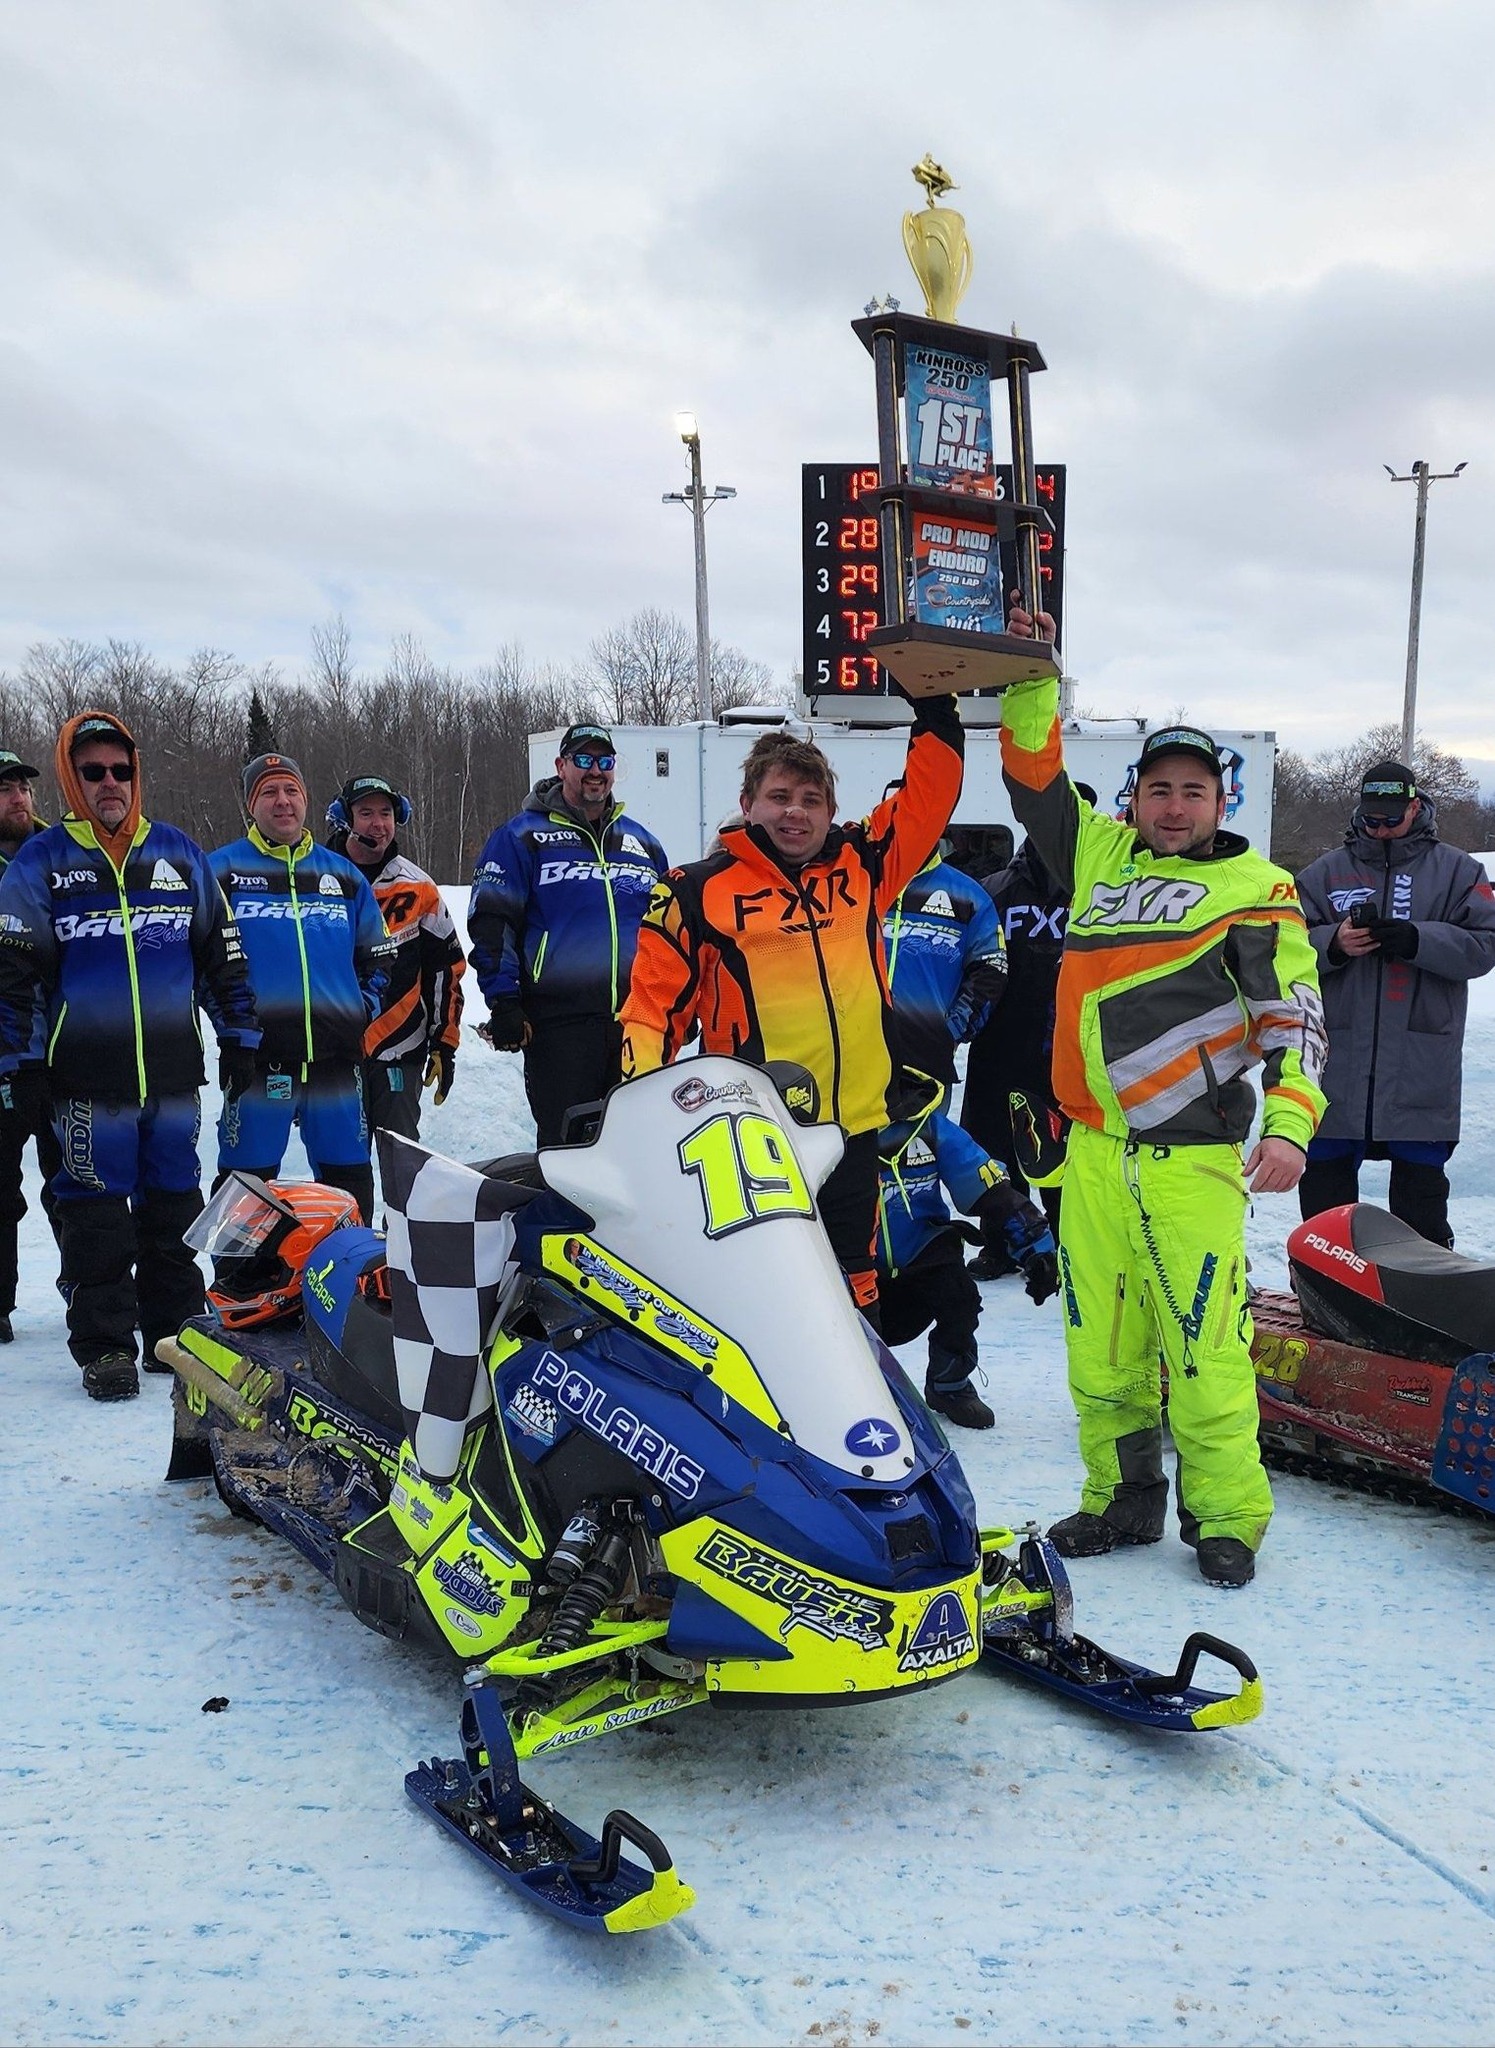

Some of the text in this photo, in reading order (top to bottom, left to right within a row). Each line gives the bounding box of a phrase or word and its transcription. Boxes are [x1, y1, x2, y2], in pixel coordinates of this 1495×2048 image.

[916, 351, 986, 377] KINROSS
[926, 368, 971, 392] 250
[917, 398, 983, 467] 1ST
[937, 443, 988, 473] PLACE
[818, 475, 826, 499] 1
[994, 476, 1006, 500] 6
[815, 518, 878, 549] 2 28
[921, 523, 991, 552] PRO MOD
[928, 548, 988, 574] ENDURO
[816, 565, 878, 595] 3 29
[939, 574, 981, 587] 250 LAP
[945, 594, 991, 609] Countryside
[816, 614, 831, 639] 4
[817, 657, 878, 686] 5 67
[734, 868, 858, 932] FXR
[1072, 875, 1211, 928] FXR
[1268, 883, 1299, 902] FX
[1392, 874, 1414, 920] CING
[234, 901, 349, 922] BAUER
[883, 917, 962, 935] OMMIE
[920, 905, 956, 918] AXALTA
[1005, 905, 1069, 941] FX
[55, 913, 193, 942] BAUER
[882, 924, 961, 948] UER
[677, 1111, 817, 1241] 19
[1304, 1233, 1369, 1274] POLARIS
[306, 1266, 337, 1314] POLARIS
[581, 1246, 719, 1348] In Memory of Our Dearest
[1182, 1252, 1219, 1341] BAUER
[1254, 1333, 1310, 1384] 28
[1395, 1390, 1430, 1402] TRANSPORT
[511, 1391, 558, 1434] MIRA
[532, 1350, 706, 1500] POLARIS
[319, 1407, 400, 1462] TOMMIE
[455, 1561, 484, 1587] Team
[699, 1533, 882, 1631] BAUER
[753, 1551, 884, 1611] TOMMIE
[780, 1601, 885, 1651] Racing
[899, 1635, 975, 1672] AXALTA
[532, 1693, 693, 1755] Auto Solutions
